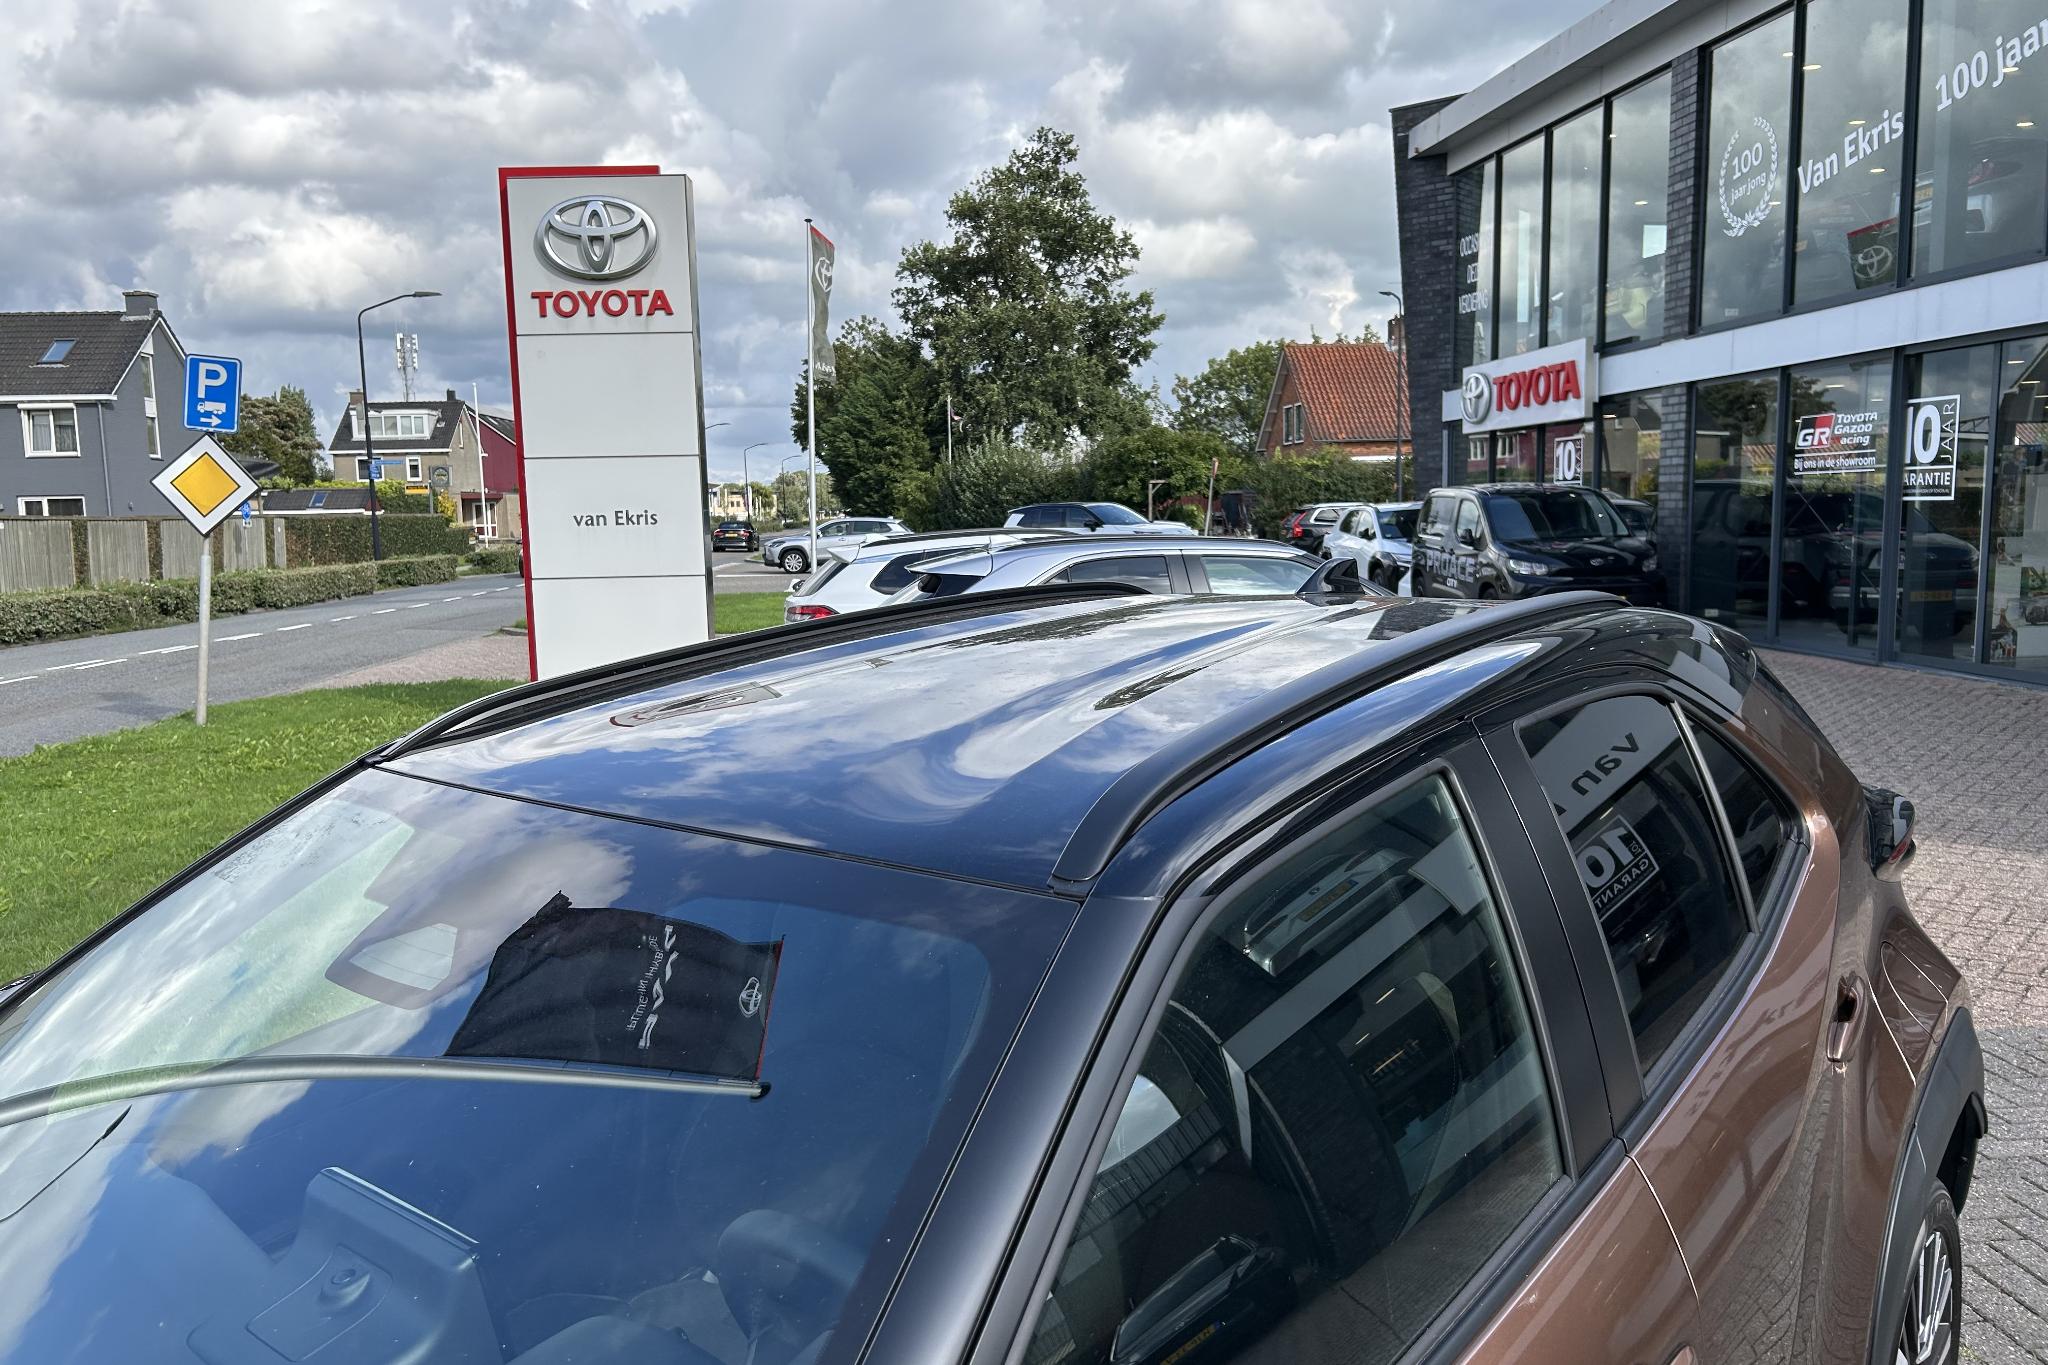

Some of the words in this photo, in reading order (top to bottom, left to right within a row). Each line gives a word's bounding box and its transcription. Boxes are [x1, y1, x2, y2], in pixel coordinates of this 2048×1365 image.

[1797, 152, 1839, 194] Van
[1844, 109, 1905, 168] Ekris
[1935, 50, 1989, 112] 100
[1992, 18, 2048, 88] jaar
[1732, 142, 1763, 180] 100
[1731, 184, 1747, 206] jaar
[1747, 172, 1767, 196] jong
[531, 289, 675, 318] TOYOTA
[197, 362, 228, 399] P
[1493, 360, 1581, 412] TOYOTA
[1834, 423, 1873, 435] GAZOO
[1836, 412, 1878, 424] TOYOTA
[1940, 402, 1955, 462] JAAR
[1797, 427, 1831, 447] GR
[1556, 441, 1576, 480] 10
[1794, 458, 1804, 471] Bij
[1804, 459, 1816, 469] ons
[1817, 457, 1825, 468] in
[1825, 457, 1835, 468] de
[1835, 455, 1876, 467] showroom
[1904, 472, 1951, 486] ARANTIE
[573, 514, 608, 527] van
[614, 509, 658, 526] Ekris
[1426, 549, 1475, 583] PROACE
